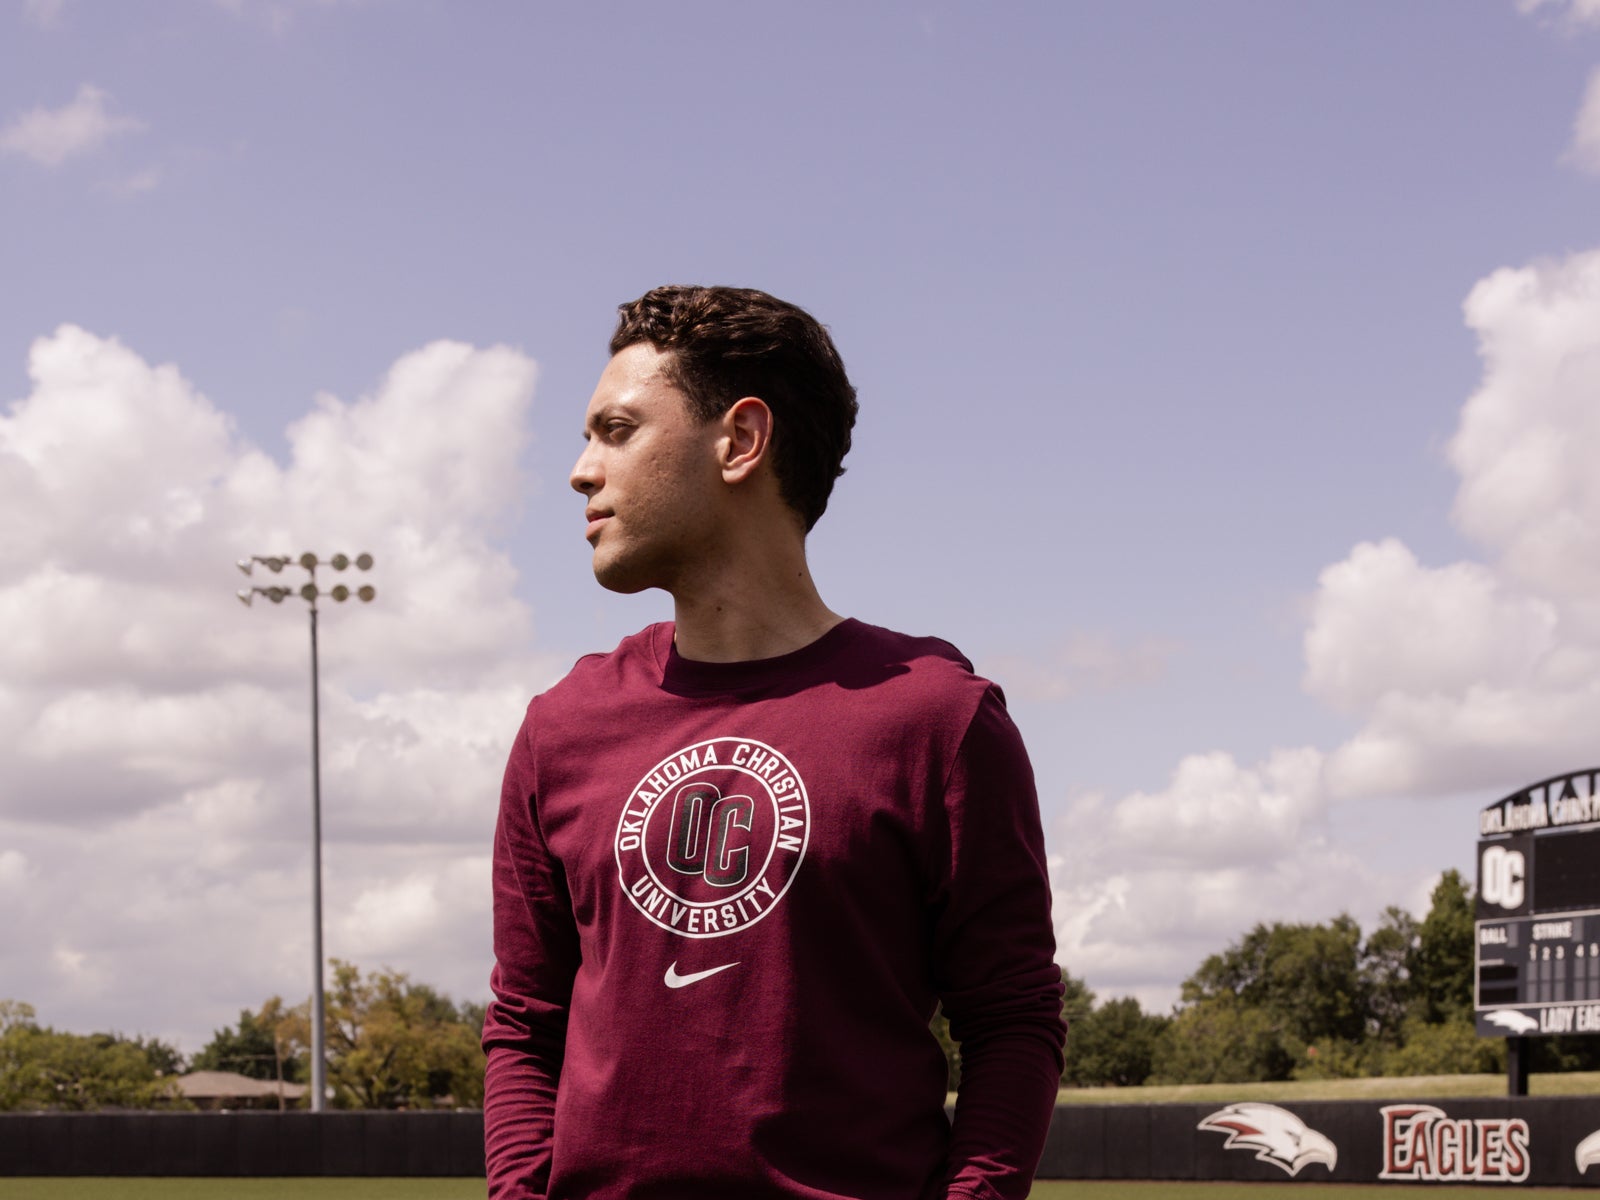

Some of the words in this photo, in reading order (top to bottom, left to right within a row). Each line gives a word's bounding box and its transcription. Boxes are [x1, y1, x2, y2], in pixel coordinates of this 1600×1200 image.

[619, 744, 718, 852] OKLAHOMA
[731, 744, 804, 853] CHRISTIAN
[1480, 801, 1548, 835] OKLAHOMA
[666, 782, 754, 887] OC
[631, 874, 776, 933] UNIVERSITY
[1481, 845, 1525, 910] OC
[1480, 927, 1507, 945] BALL
[1532, 921, 1573, 940] STRIKE
[1540, 1006, 1574, 1034] LADY
[1378, 1104, 1530, 1182] EAGLES
